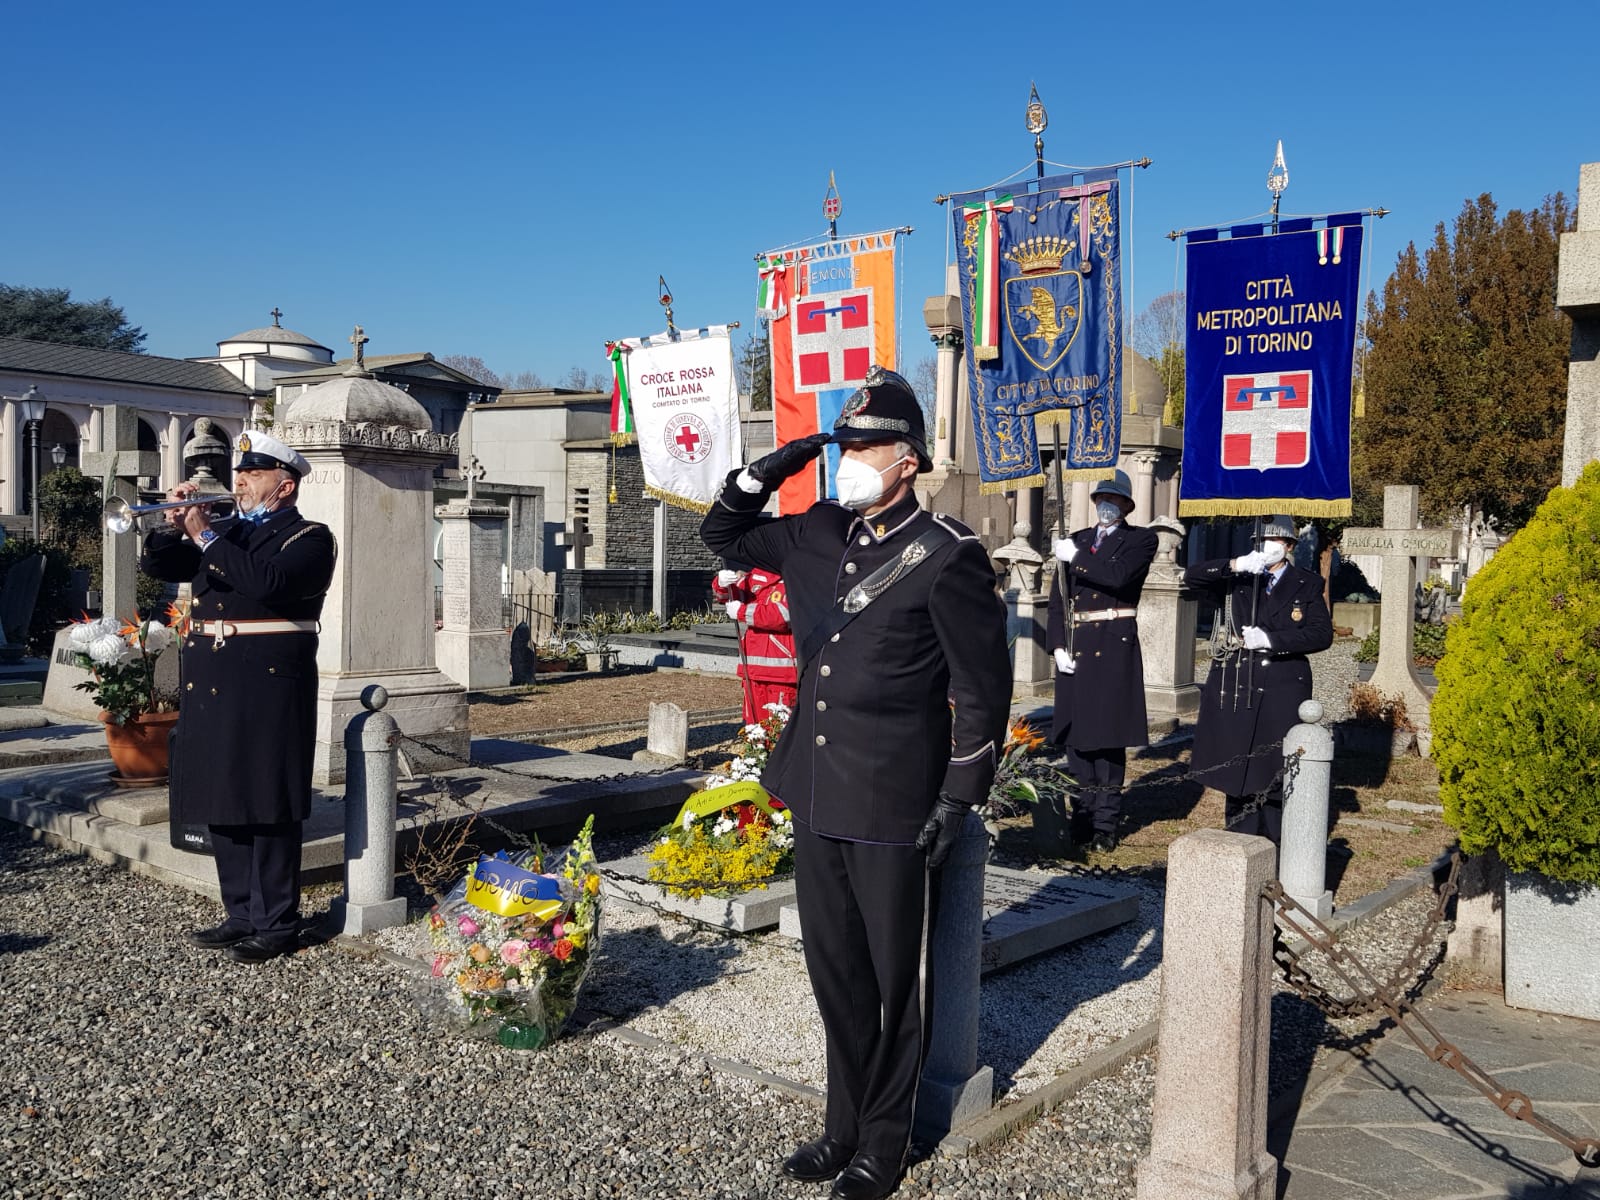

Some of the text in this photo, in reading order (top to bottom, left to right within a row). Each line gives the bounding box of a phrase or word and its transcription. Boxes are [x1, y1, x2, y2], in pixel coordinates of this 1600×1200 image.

[1245, 274, 1294, 300] CITTÀ
[1197, 300, 1343, 330] METROPOLITANA
[1224, 330, 1313, 355] DI TORINO
[640, 366, 715, 385] CROCE ROSSA
[1040, 379, 1050, 392] DI
[1053, 374, 1099, 392] TORINO
[657, 382, 703, 398] ITALIANA
[652, 399, 680, 408] COMITATO
[690, 396, 711, 404] TORINO
[303, 470, 341, 484] DUZIO
[1347, 537, 1394, 549] FAMIGLIA
